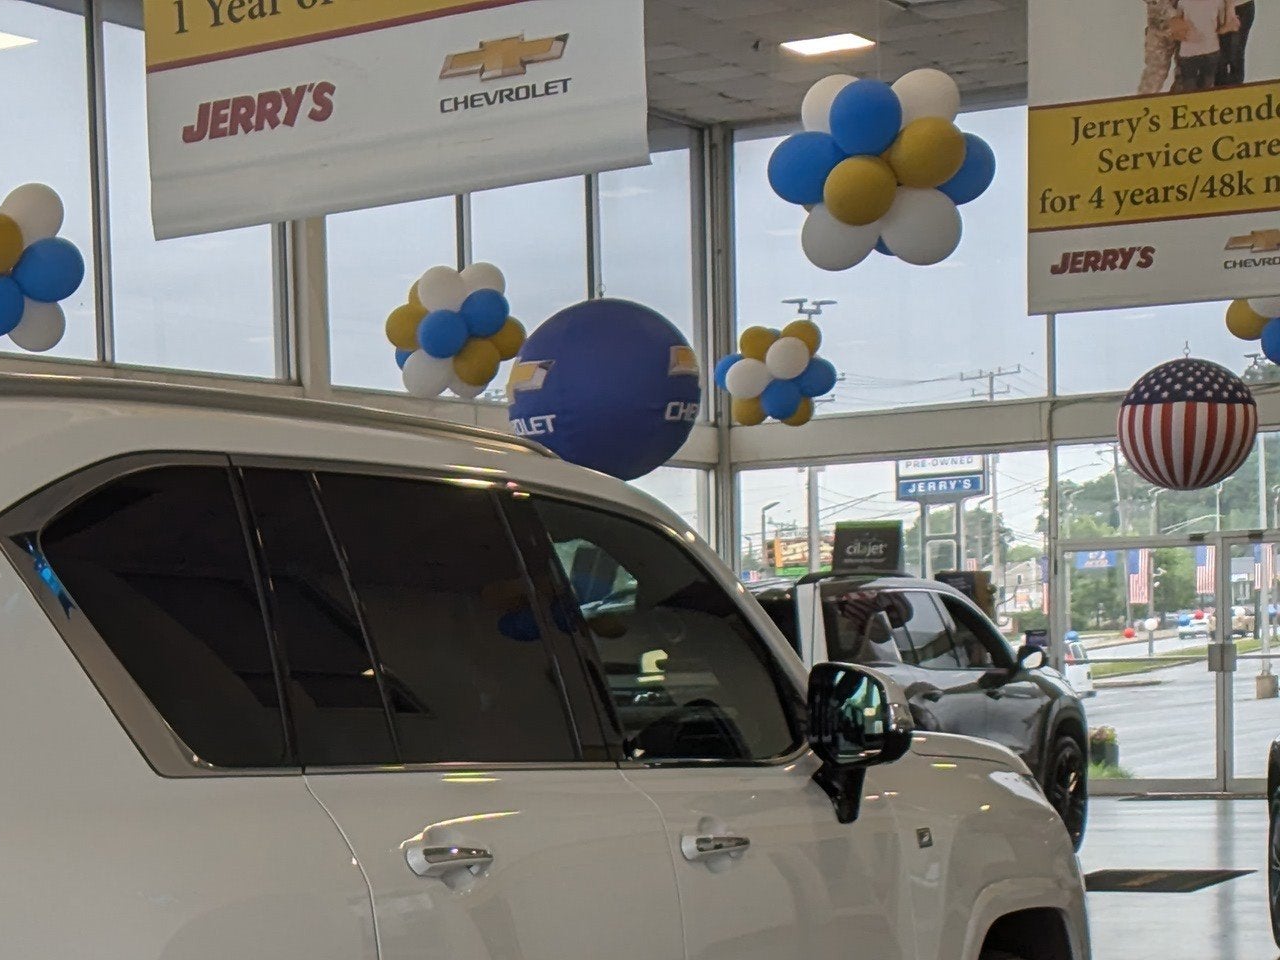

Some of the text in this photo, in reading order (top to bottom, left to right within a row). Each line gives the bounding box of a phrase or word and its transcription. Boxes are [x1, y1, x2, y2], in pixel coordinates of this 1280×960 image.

[181, 77, 573, 144] JERRY'S CHEVROLET
[1071, 107, 1161, 146] Jerry's
[1097, 142, 1203, 174] Service
[1039, 187, 1081, 214] for
[1088, 185, 1105, 209] 4
[1112, 170, 1255, 216] years/48k
[1050, 245, 1156, 275] JERRY'S
[907, 478, 972, 494] JERRY'S
